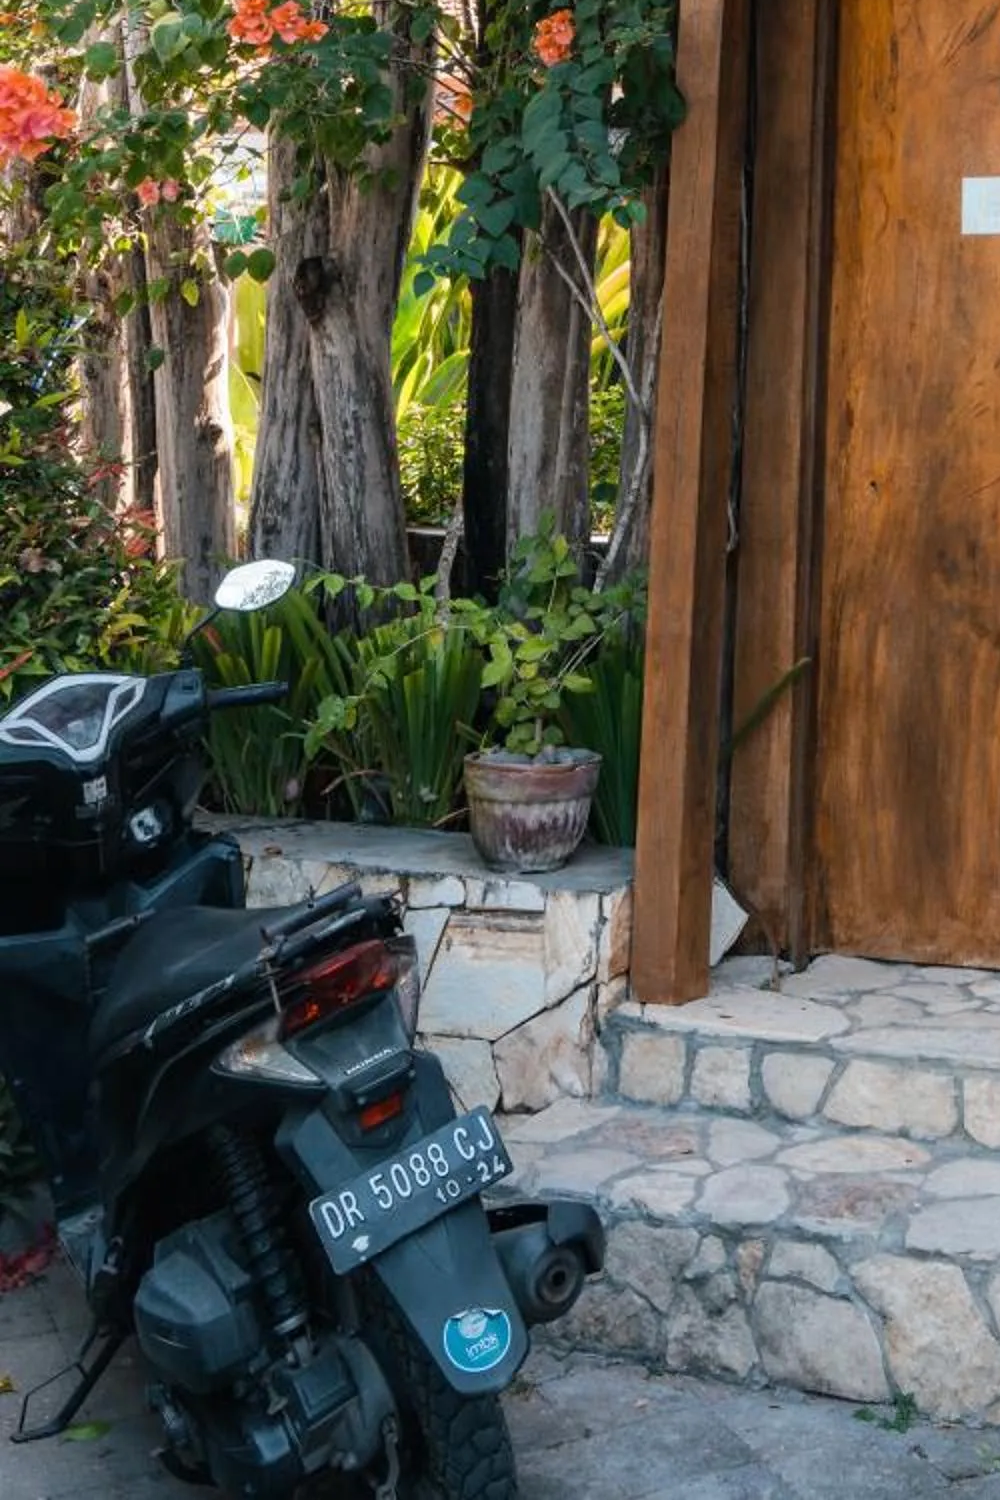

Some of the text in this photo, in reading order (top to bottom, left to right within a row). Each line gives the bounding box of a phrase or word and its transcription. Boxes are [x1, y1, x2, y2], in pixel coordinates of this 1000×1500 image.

[320, 1115, 494, 1239] DR 5088 CJ
